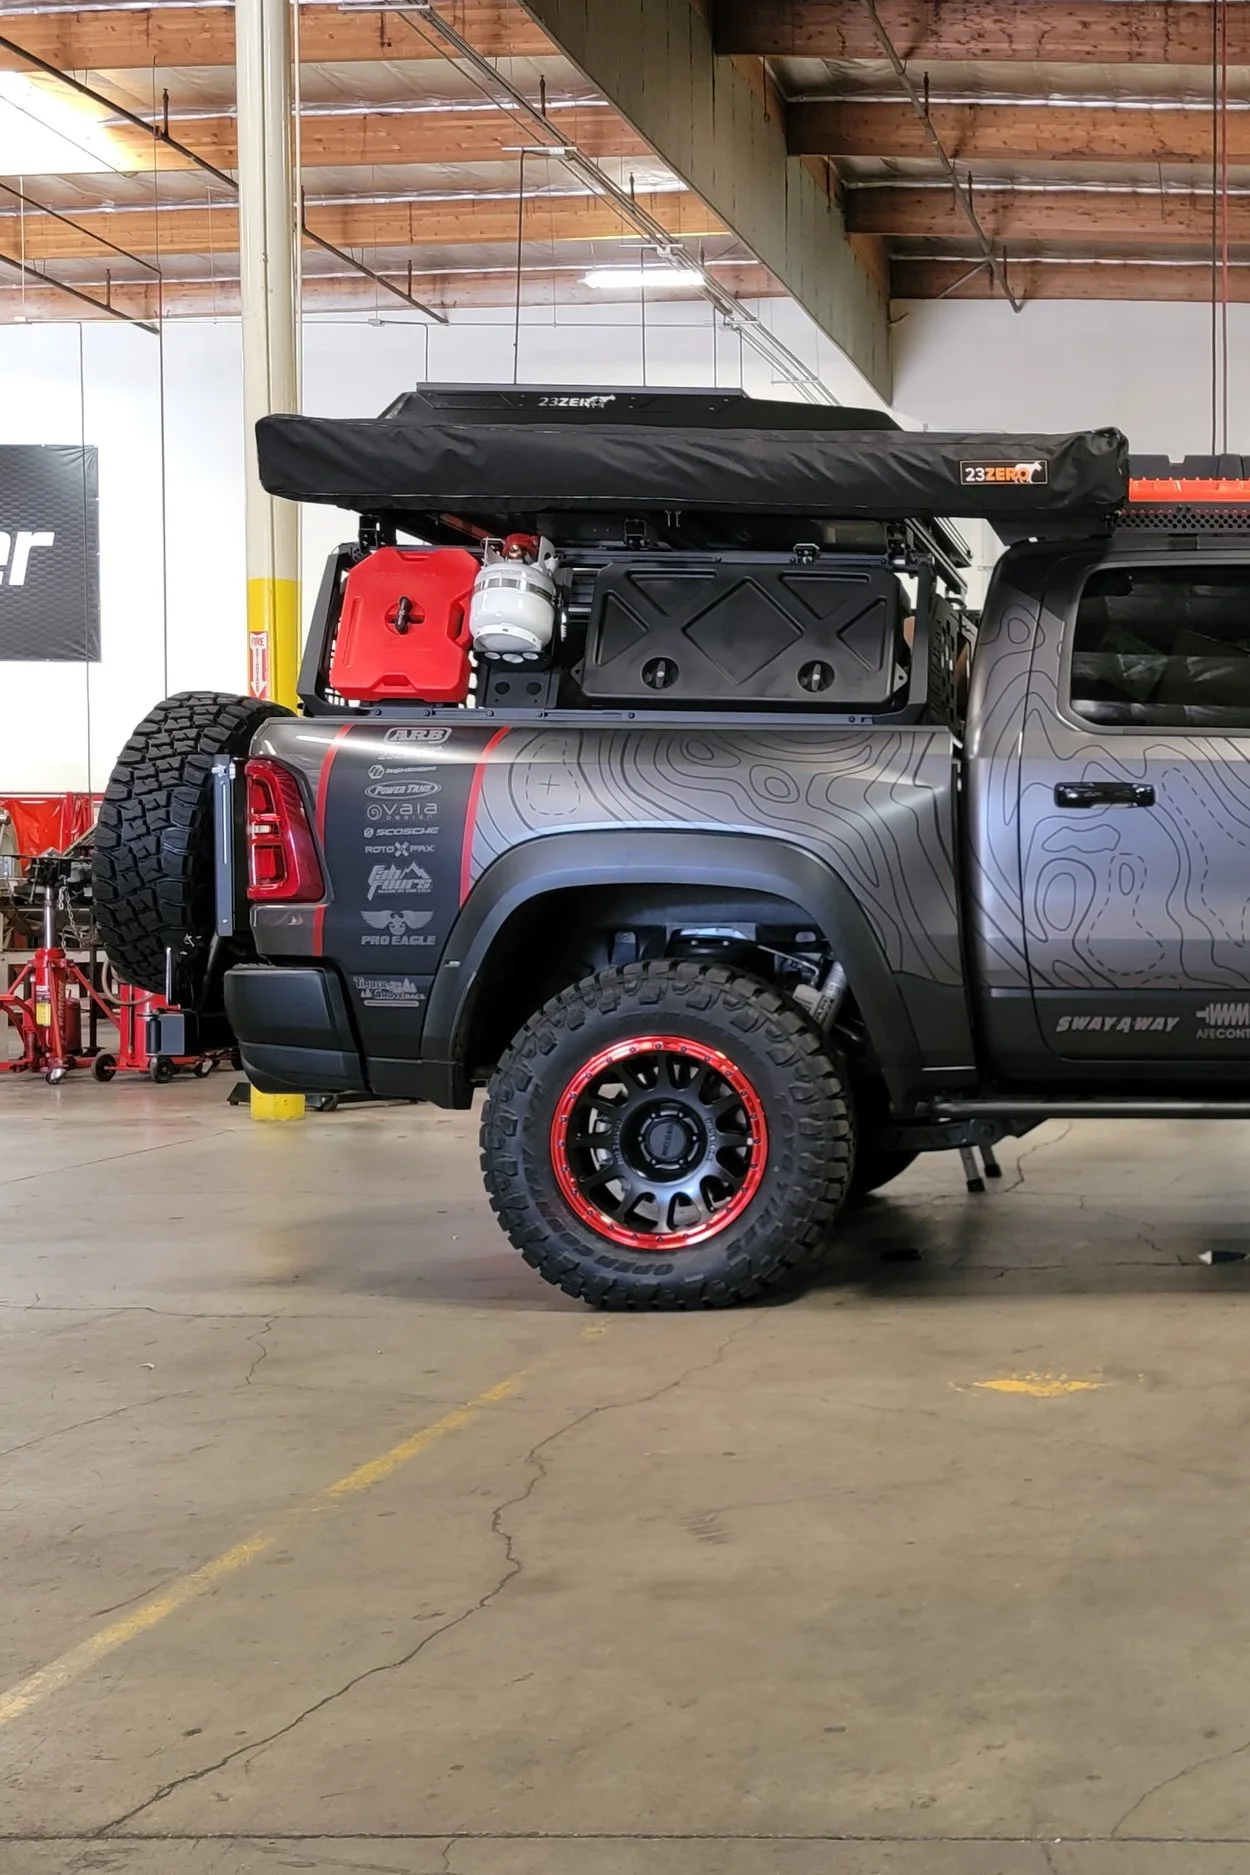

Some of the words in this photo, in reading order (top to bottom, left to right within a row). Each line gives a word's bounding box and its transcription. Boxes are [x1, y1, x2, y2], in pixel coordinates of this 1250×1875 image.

[965, 467, 1030, 482] 23ZERO
[0, 531, 55, 586] r
[389, 730, 445, 741] ARB
[361, 935, 390, 945] PRO
[392, 935, 437, 945] EAGLE
